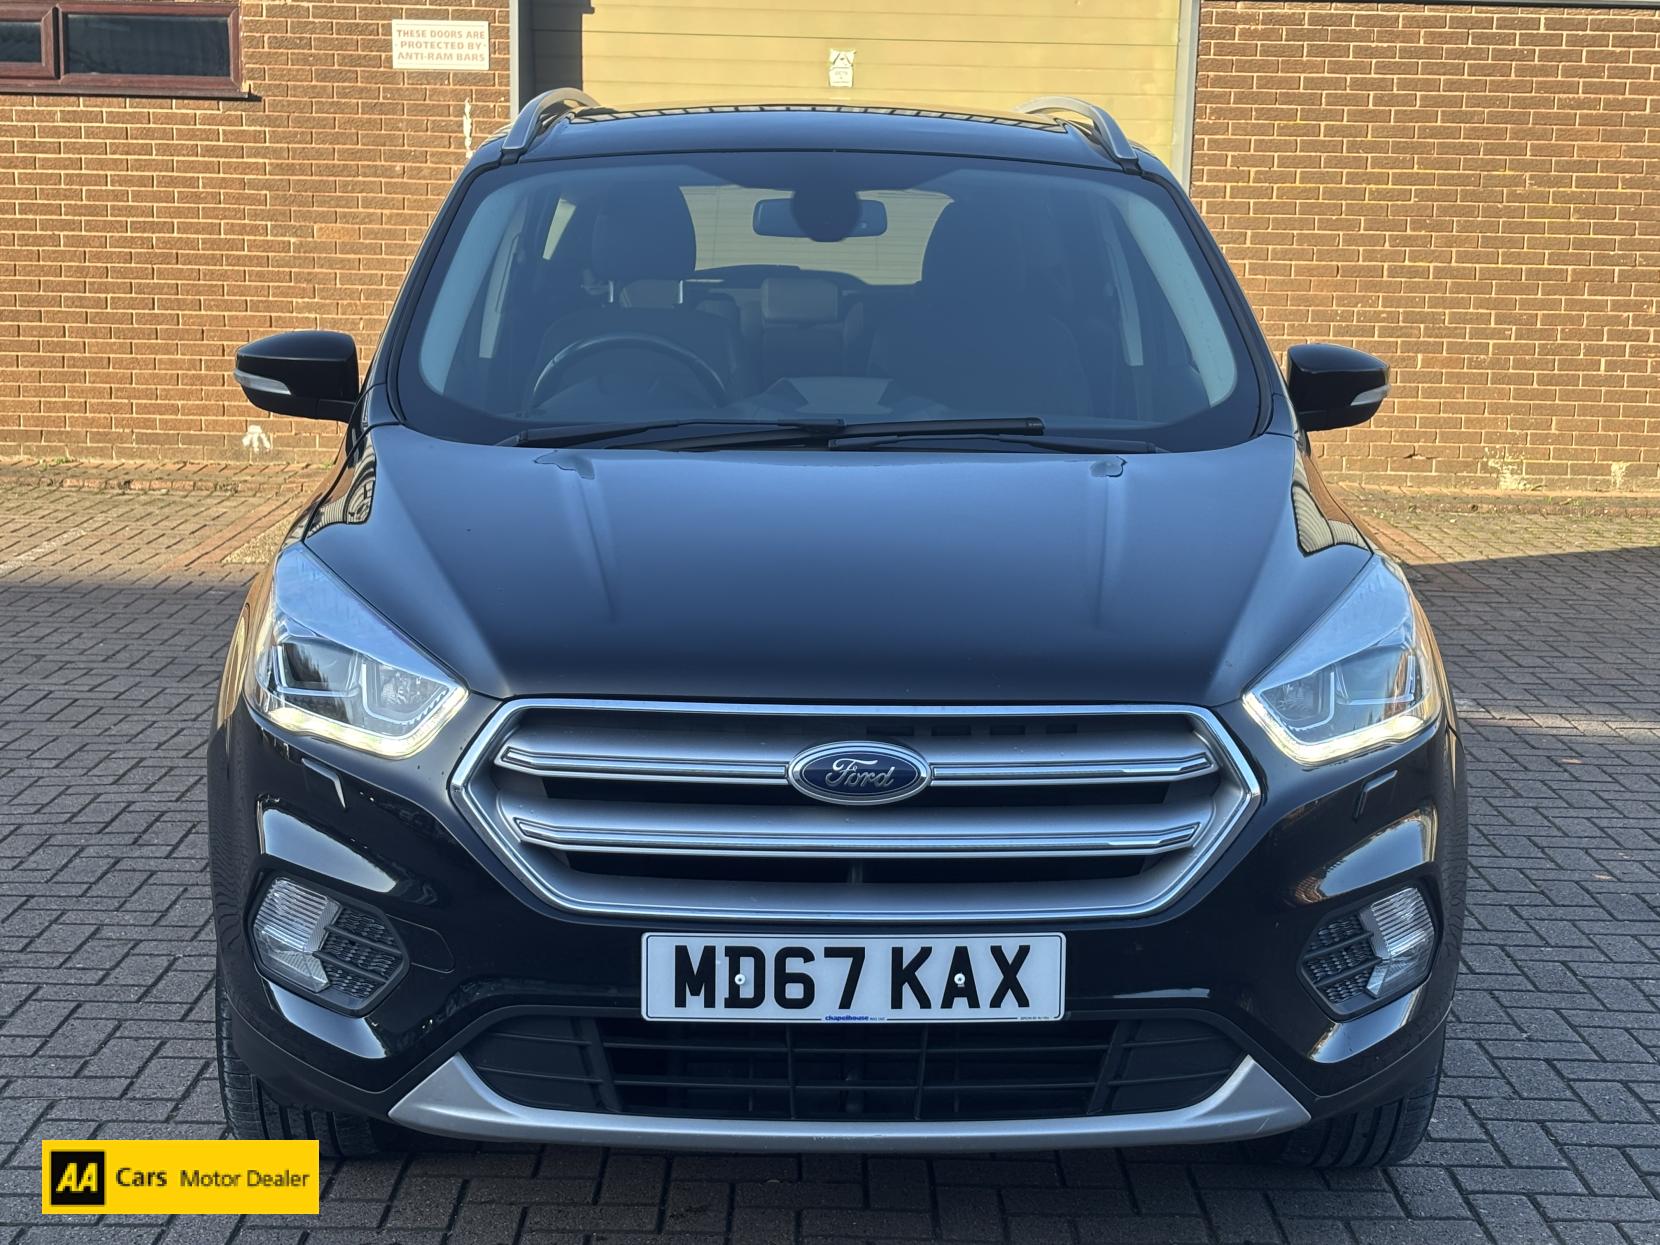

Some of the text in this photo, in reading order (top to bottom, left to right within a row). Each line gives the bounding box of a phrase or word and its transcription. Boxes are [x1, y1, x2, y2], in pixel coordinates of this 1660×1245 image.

[396, 29, 485, 39] THESE DOORS ARE
[400, 41, 482, 50] PROTECTED BY
[397, 52, 485, 62] ANTI-RAM BARS
[825, 758, 895, 787] Ford
[674, 944, 1031, 1010] MD67 KAX
